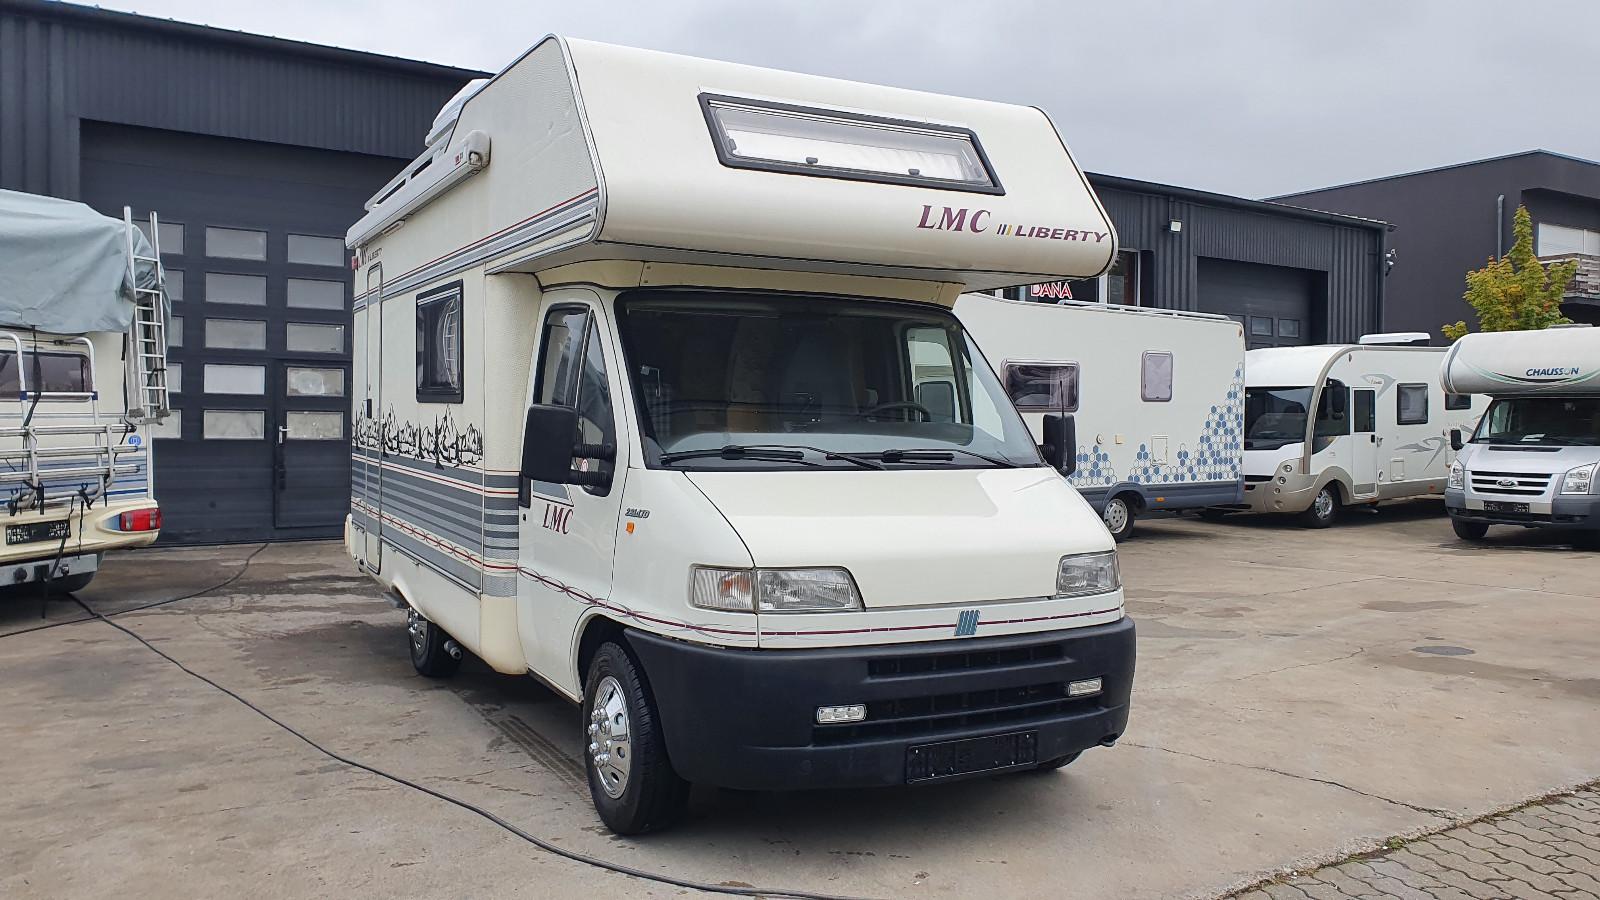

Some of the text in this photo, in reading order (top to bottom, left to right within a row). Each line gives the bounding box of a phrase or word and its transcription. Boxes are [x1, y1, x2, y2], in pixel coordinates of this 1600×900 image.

[917, 205, 1108, 243] LMC LIBERTY
[1030, 282, 1073, 299] DANA
[1525, 367, 1579, 377] CHAUSSON
[542, 503, 574, 535] LMC
